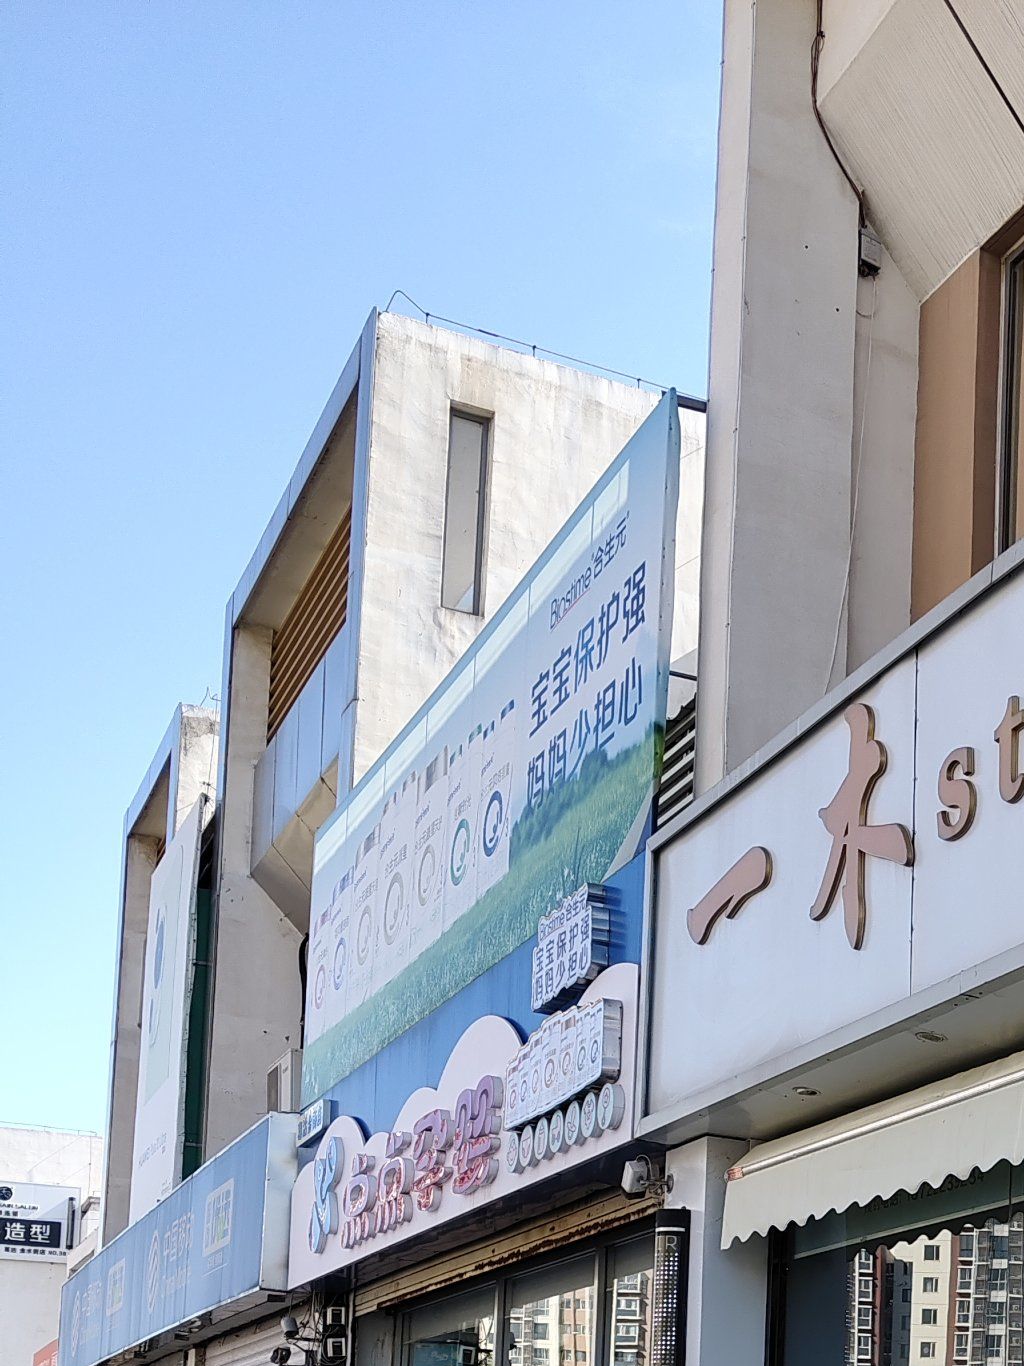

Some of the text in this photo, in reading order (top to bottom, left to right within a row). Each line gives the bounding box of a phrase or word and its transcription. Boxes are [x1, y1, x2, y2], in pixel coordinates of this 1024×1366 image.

[529, 560, 646, 738] 宝宝保护强
[527, 656, 642, 808] 妈妈少担心
[535, 917, 590, 975] 宝宝保护强
[534, 947, 590, 1005] 妈妈少担心
[5, 1222, 51, 1244] 造型
